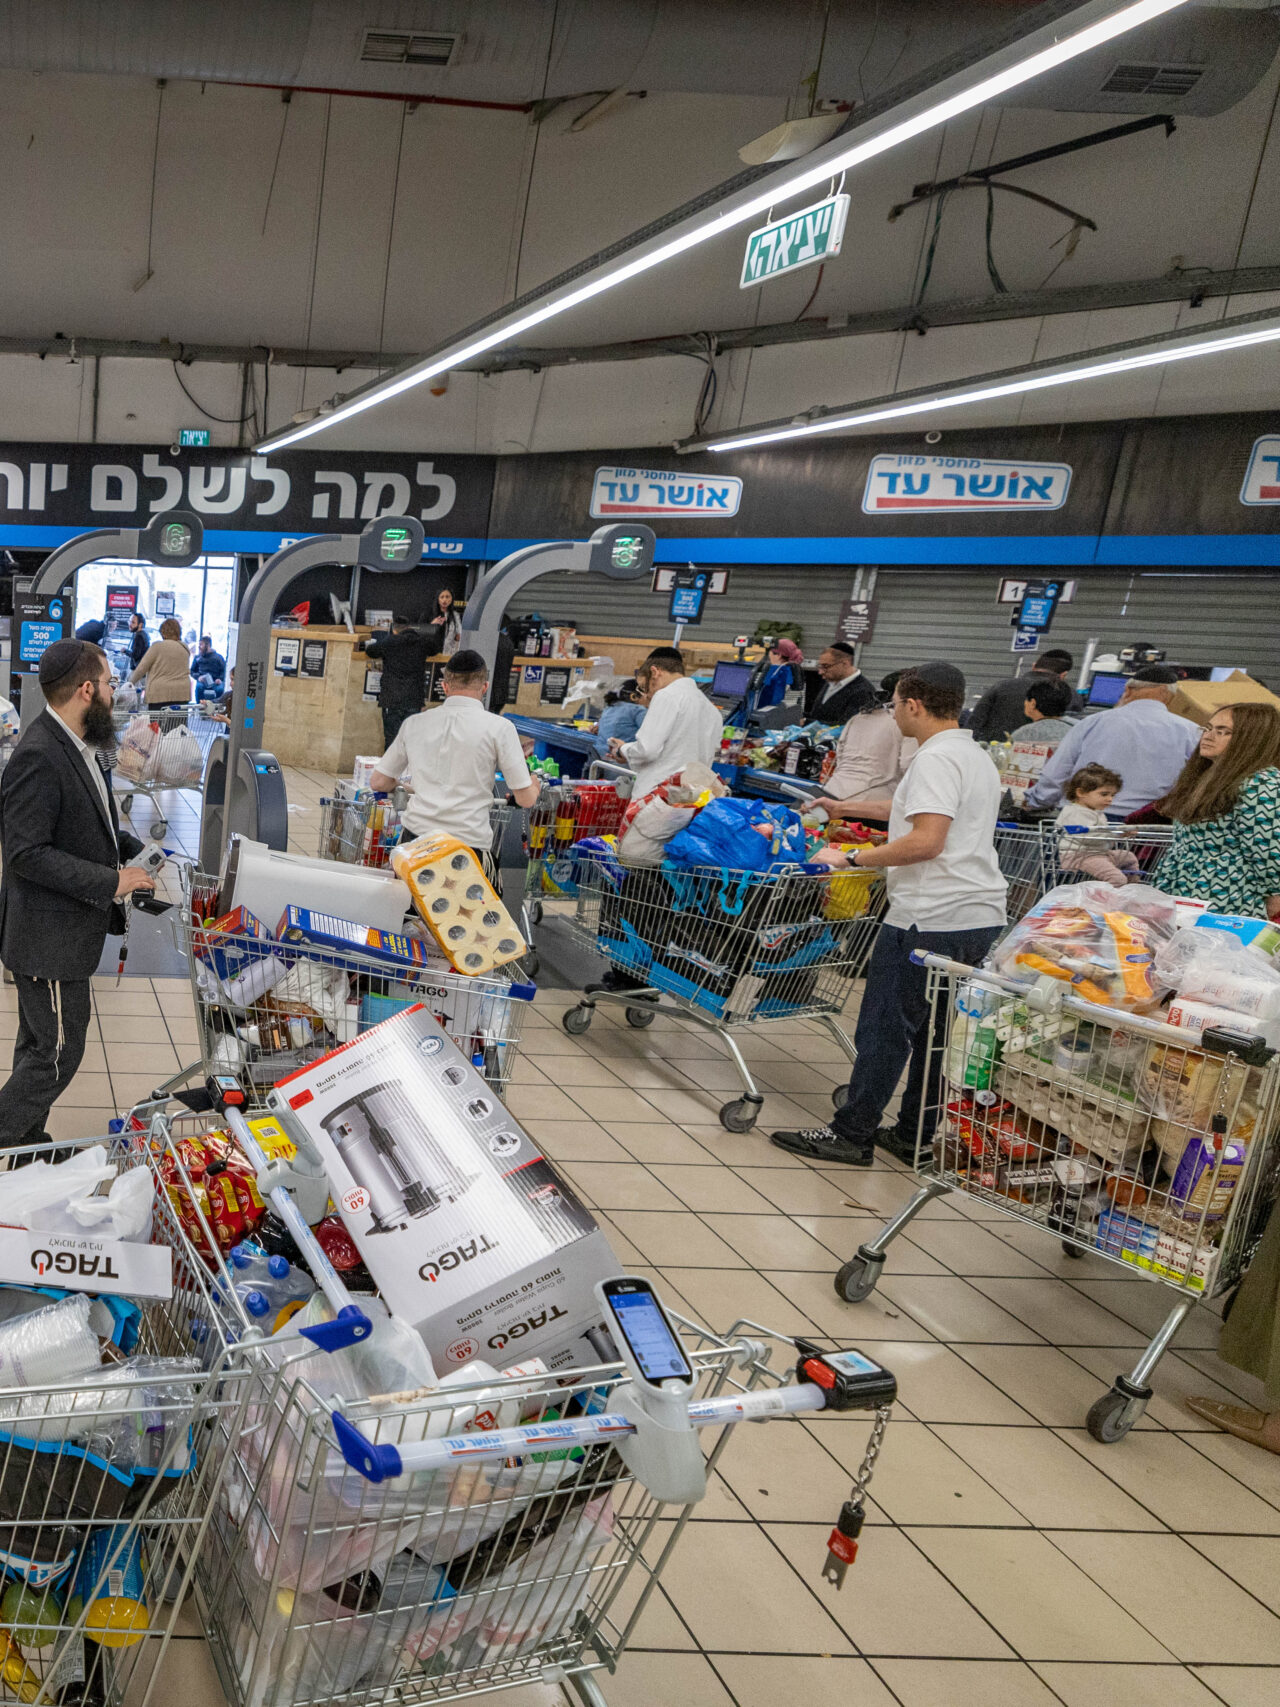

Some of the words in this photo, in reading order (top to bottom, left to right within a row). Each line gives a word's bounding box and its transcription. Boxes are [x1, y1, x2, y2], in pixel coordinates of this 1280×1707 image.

[754, 205, 832, 279] יציאה
[182, 430, 208, 445] יציאה
[615, 468, 636, 478] מזון
[897, 456, 926, 467] מזון
[932, 457, 981, 469] מחסני
[90, 454, 291, 516] לשלם
[640, 470, 676, 481] מחסני
[877, 472, 930, 495] עד
[943, 471, 1054, 500] אושר
[312, 462, 456, 521] למה
[600, 482, 639, 502] עד
[649, 483, 729, 508] אושר
[165, 523, 186, 551] 6
[385, 528, 407, 558] 7
[48, 598, 64, 620] 6
[33, 632, 50, 640] 500
[247, 661, 259, 699] smart
[350, 1195, 365, 1211] 60
[30, 1248, 120, 1280] TAGO
[418, 1235, 500, 1283] TAGO
[520, 1282, 534, 1294] 60
[534, 1267, 563, 1284] כוסות
[487, 1304, 569, 1350] TAGO
